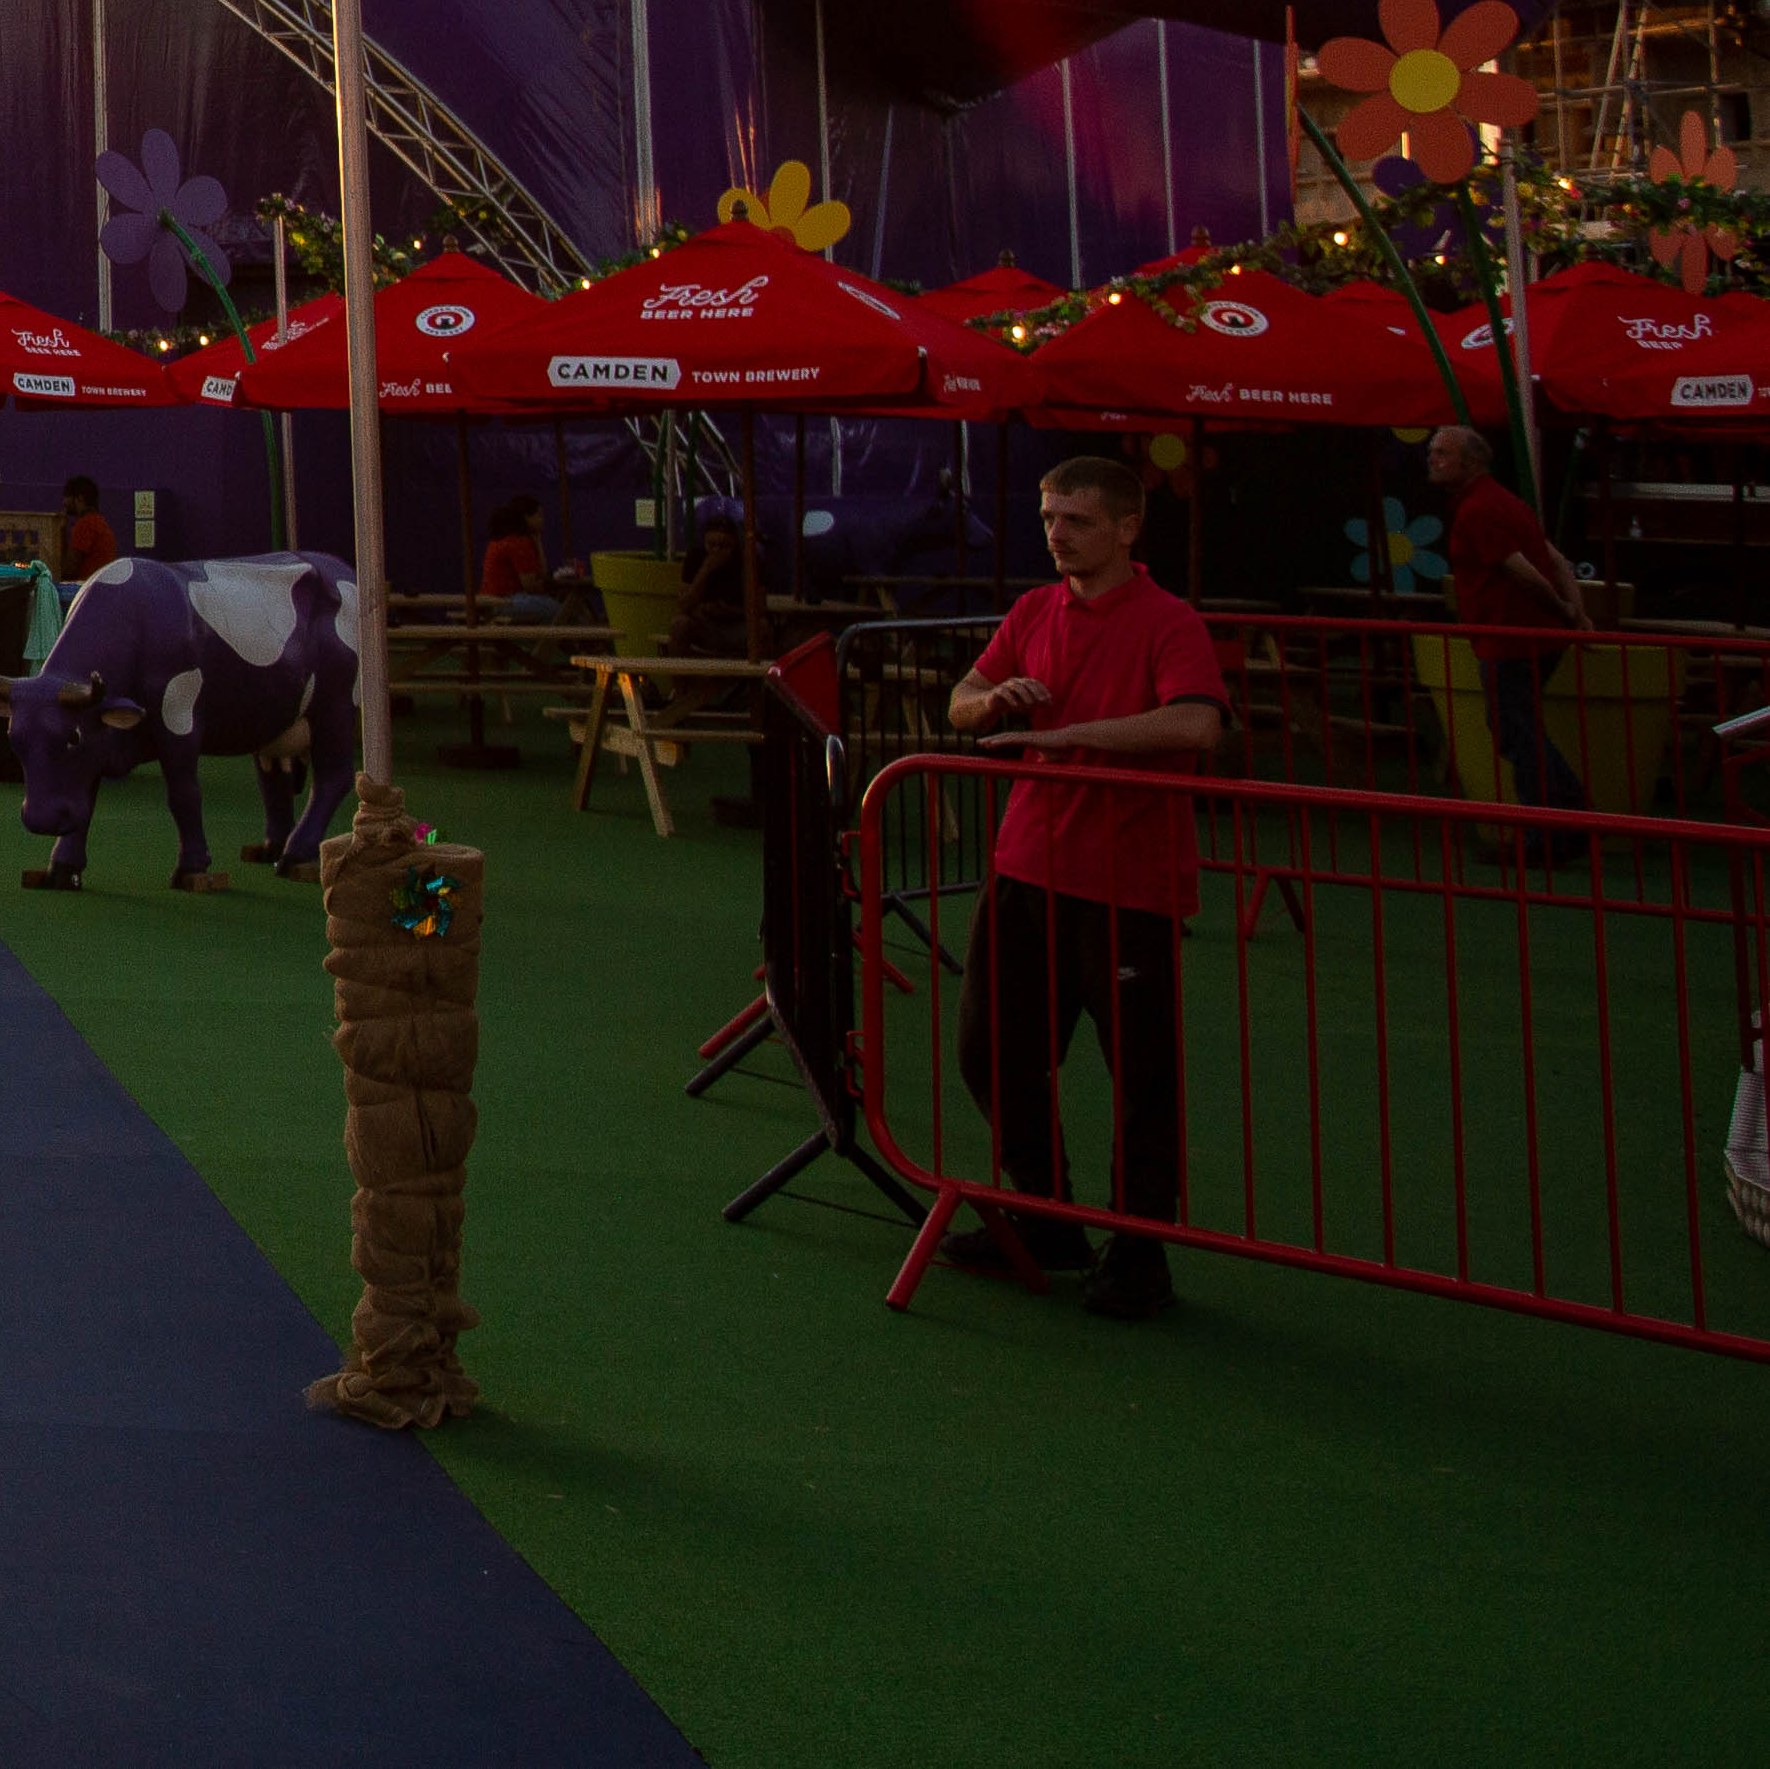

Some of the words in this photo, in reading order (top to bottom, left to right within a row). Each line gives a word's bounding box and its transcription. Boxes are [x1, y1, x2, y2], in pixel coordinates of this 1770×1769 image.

[643, 275, 769, 309] Fresh
[640, 308, 693, 319] BEER
[700, 307, 754, 319] HERE
[1618, 313, 1712, 340] Fresh
[11, 328, 70, 348] Fresh
[556, 363, 669, 382] CAMDEN
[692, 371, 740, 383] TOWN
[745, 367, 820, 382] BREWERY
[17, 377, 70, 392] CAMDEN
[81, 386, 106, 395] TOWN
[205, 380, 233, 396] CAMD
[1679, 381, 1748, 400] CAMDEN
[1239, 388, 1284, 402] BEER
[1289, 391, 1333, 405] HERE
